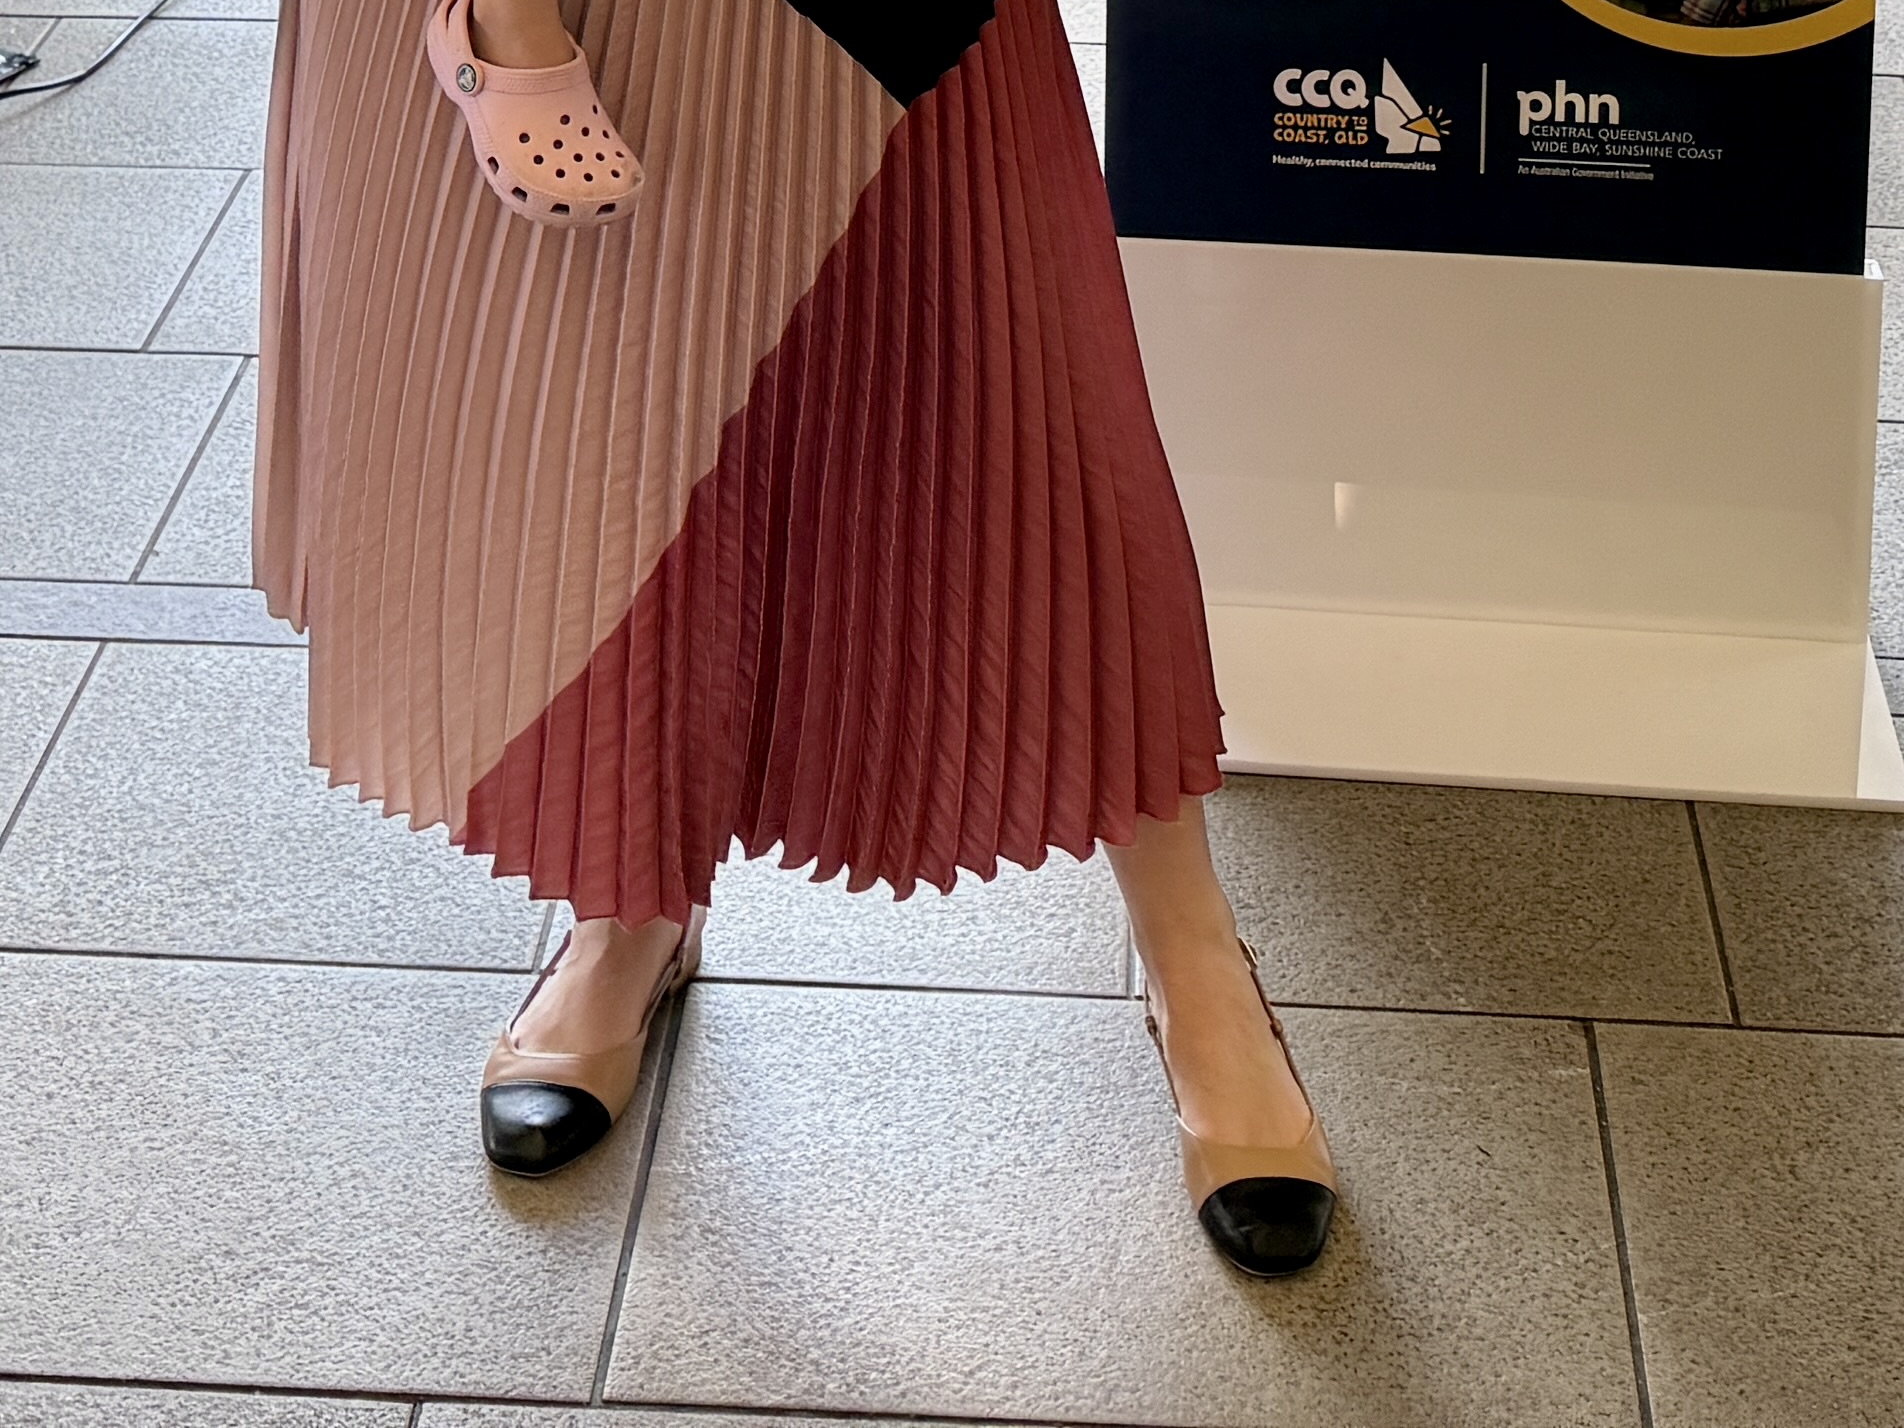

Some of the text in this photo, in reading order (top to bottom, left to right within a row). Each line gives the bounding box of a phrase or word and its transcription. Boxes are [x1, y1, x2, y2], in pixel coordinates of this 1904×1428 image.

[1273, 68, 1369, 110] CCQ
[1517, 79, 1620, 136] phn
[1273, 112, 1369, 130] COUNTRY TO
[1273, 128, 1369, 145] COAST, QLD
[1531, 125, 1696, 145] CENTRAL QUEENSLAND,
[1531, 141, 1723, 160] WIDE BAY, SUNSHINE COAST
[1315, 158, 1369, 168] connected
